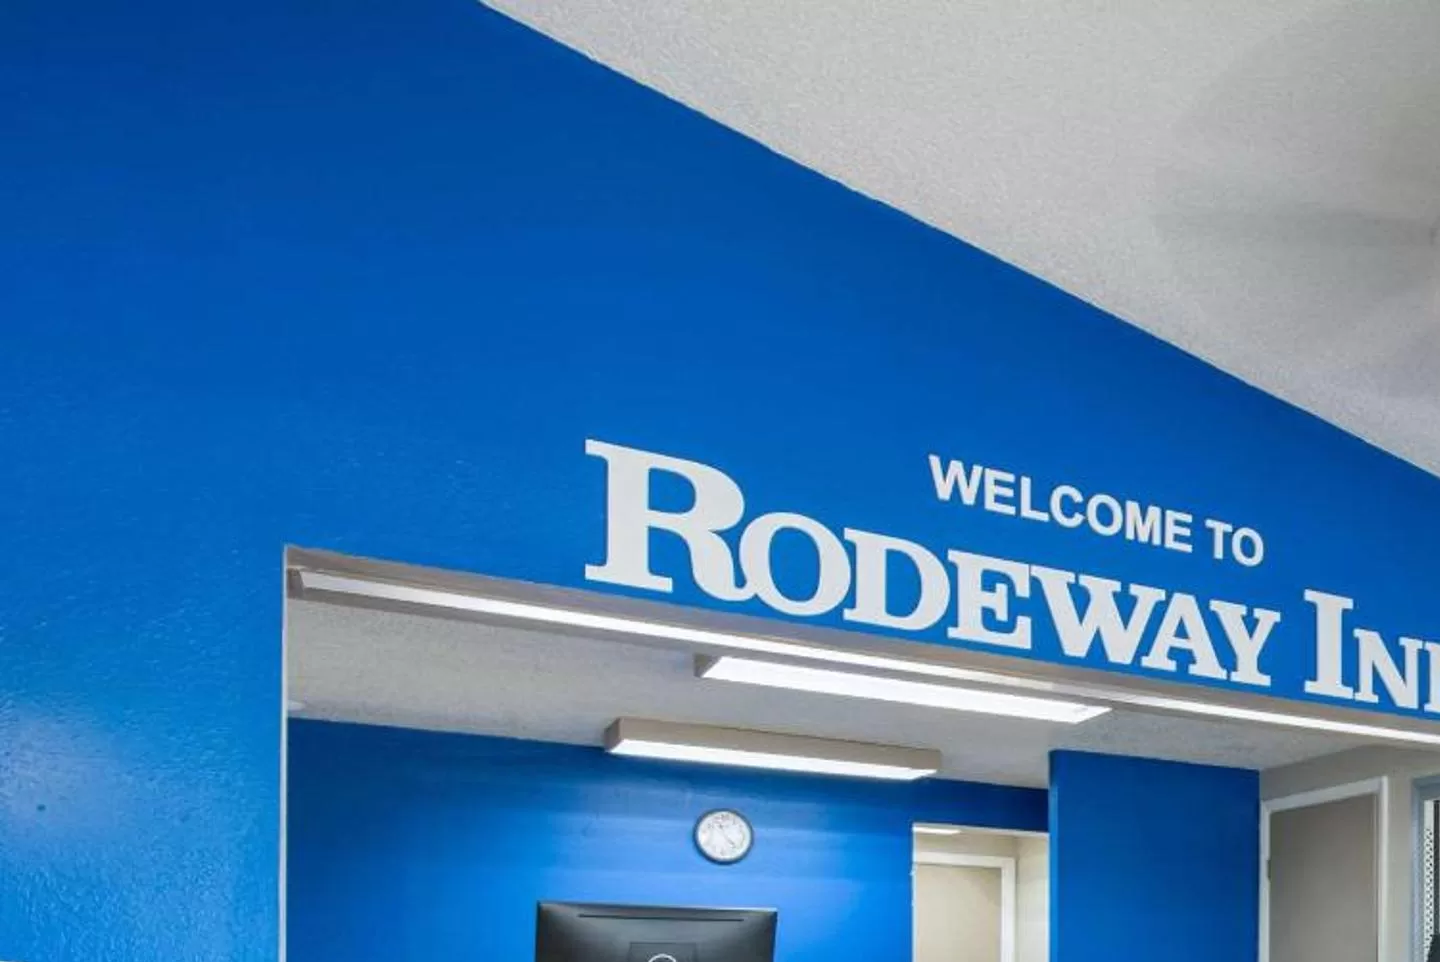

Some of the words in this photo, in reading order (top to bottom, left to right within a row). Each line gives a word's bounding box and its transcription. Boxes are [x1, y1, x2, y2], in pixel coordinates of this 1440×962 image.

[585, 439, 1281, 686] RODEWAY
[929, 455, 1192, 552] WELCOME
[1206, 519, 1264, 566] TO
